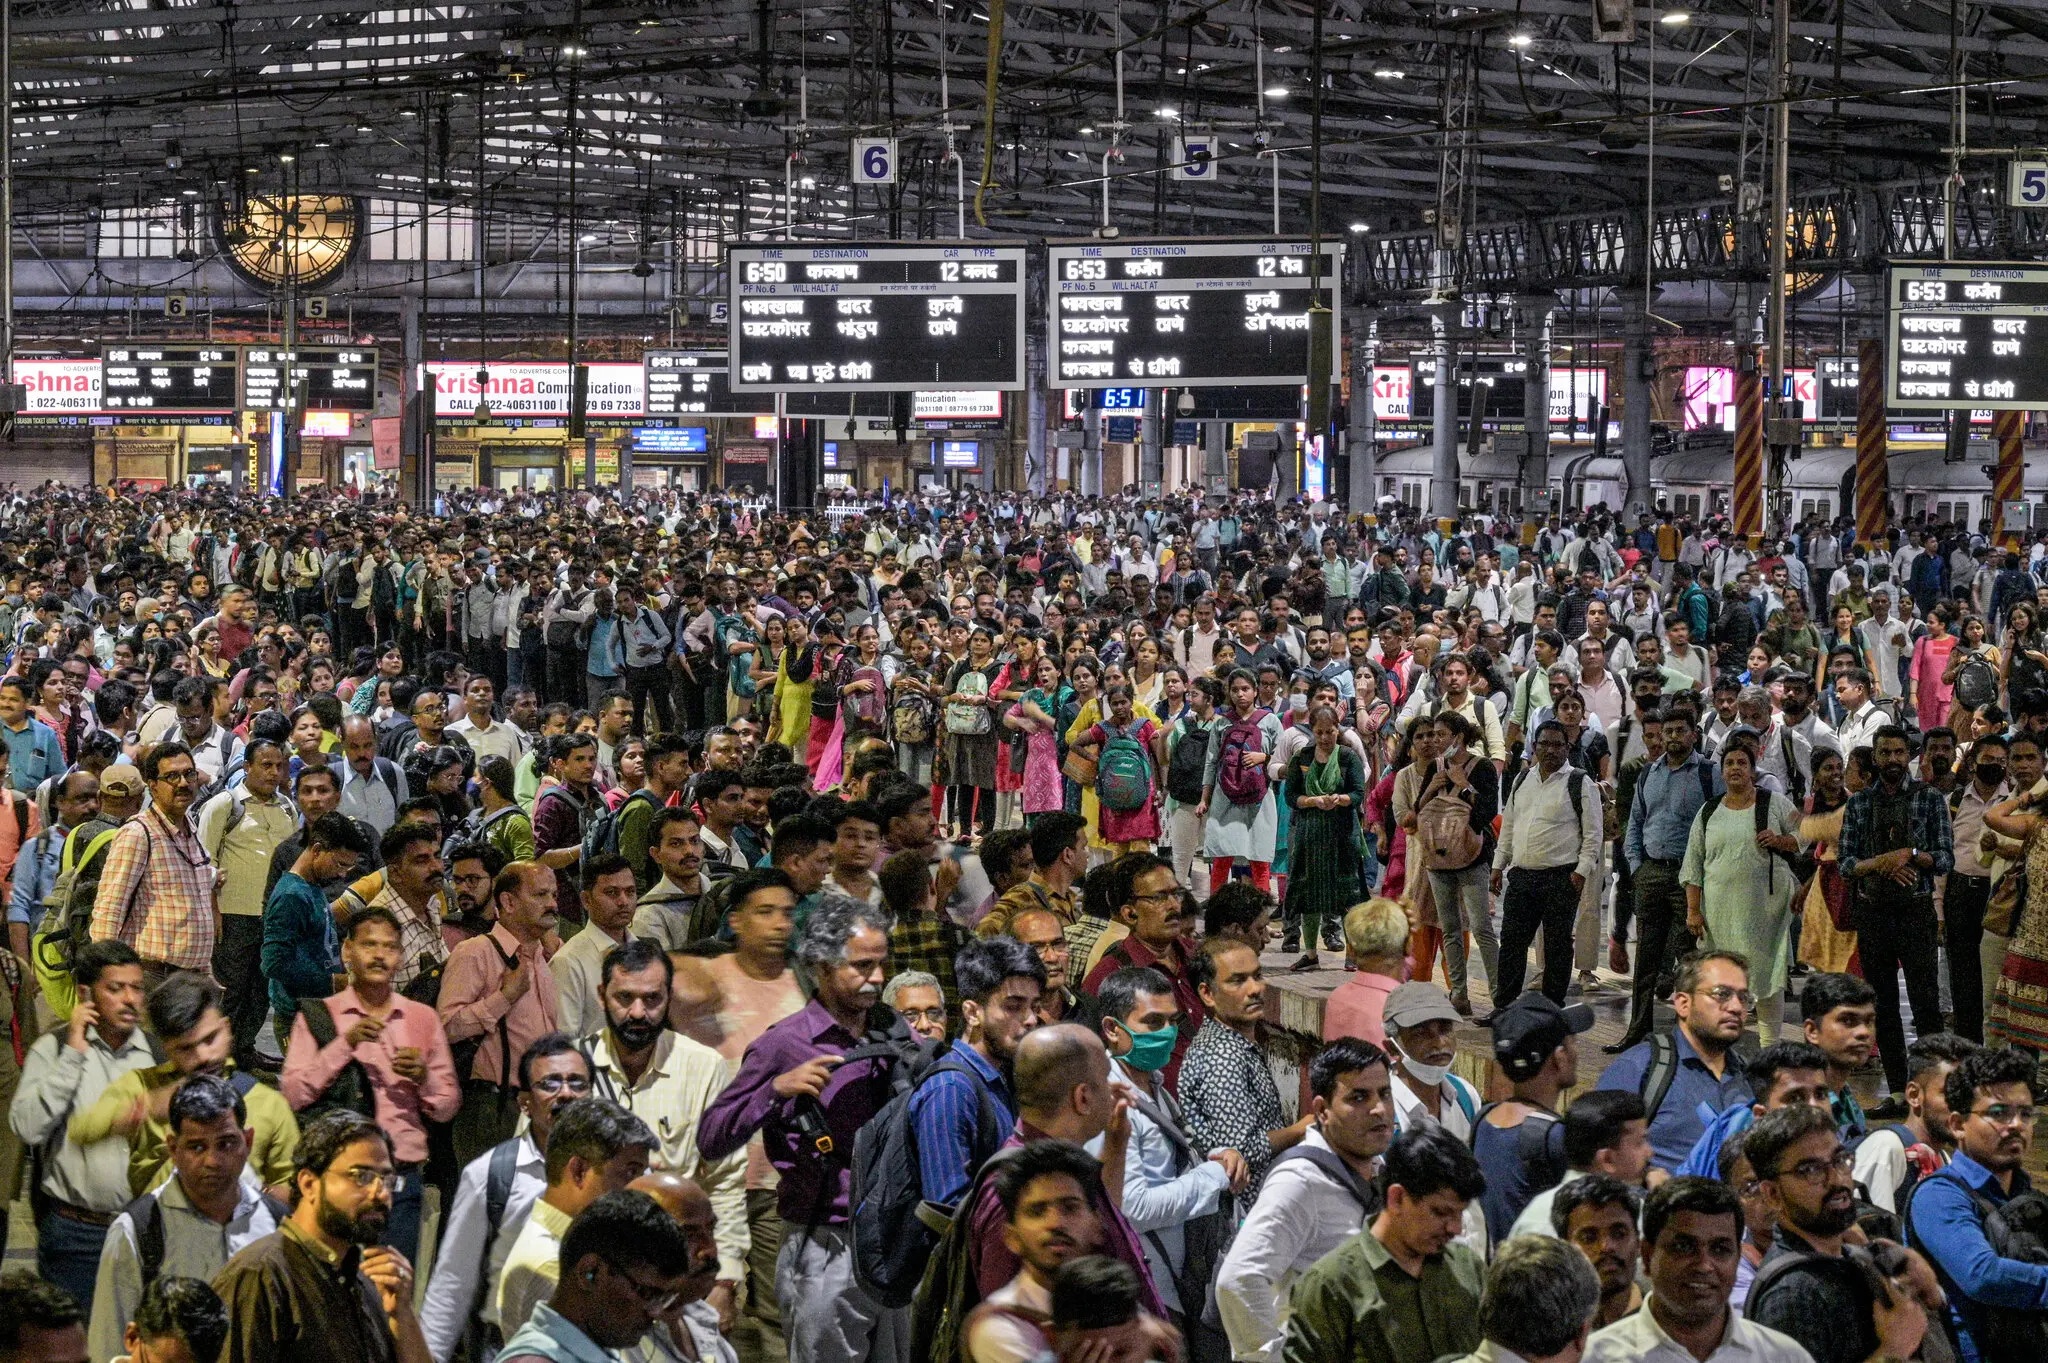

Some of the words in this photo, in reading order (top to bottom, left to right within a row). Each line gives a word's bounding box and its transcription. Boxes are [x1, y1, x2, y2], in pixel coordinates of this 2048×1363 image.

[863, 145, 889, 178] 6
[1184, 144, 1209, 176] 5
[2022, 170, 2046, 202] 5
[761, 249, 783, 258] TIME
[812, 249, 869, 258] DESTINATION
[944, 249, 959, 258] CAR
[972, 248, 996, 257] TYPE
[1081, 247, 1102, 256] TIME
[1131, 247, 1187, 256] DESTINATION
[1261, 245, 1276, 253] CAR
[1290, 244, 1312, 253] TYPE
[747, 263, 786, 282] 6:50
[806, 264, 858, 279] कल्याण
[940, 262, 959, 281] 12
[1066, 260, 1106, 279] 6:53
[1257, 257, 1276, 276] 12
[1921, 269, 1942, 277] TIME
[1970, 270, 2024, 278] DESTINATION
[743, 285, 754, 293] PF
[793, 284, 810, 293] WILL
[812, 284, 829, 293] HALT
[830, 284, 839, 292] AT
[1062, 283, 1072, 291] PF
[1112, 282, 1128, 290] WILL
[1130, 281, 1148, 290] HALT
[1149, 281, 1158, 289] AT
[1908, 282, 1946, 301] 6:53
[169, 300, 181, 314] 6
[311, 301, 321, 315] 5
[715, 304, 727, 319] 5
[1062, 340, 1114, 355] कल्याण
[1062, 362, 1114, 376] कल्याण
[13, 371, 89, 391] ishna
[537, 382, 631, 394] Commication
[1900, 382, 1950, 396] कल्याण
[449, 400, 474, 410] CALL
[601, 401, 613, 410] 69
[616, 401, 641, 410] 7338
[1105, 389, 1143, 407] 6:51
